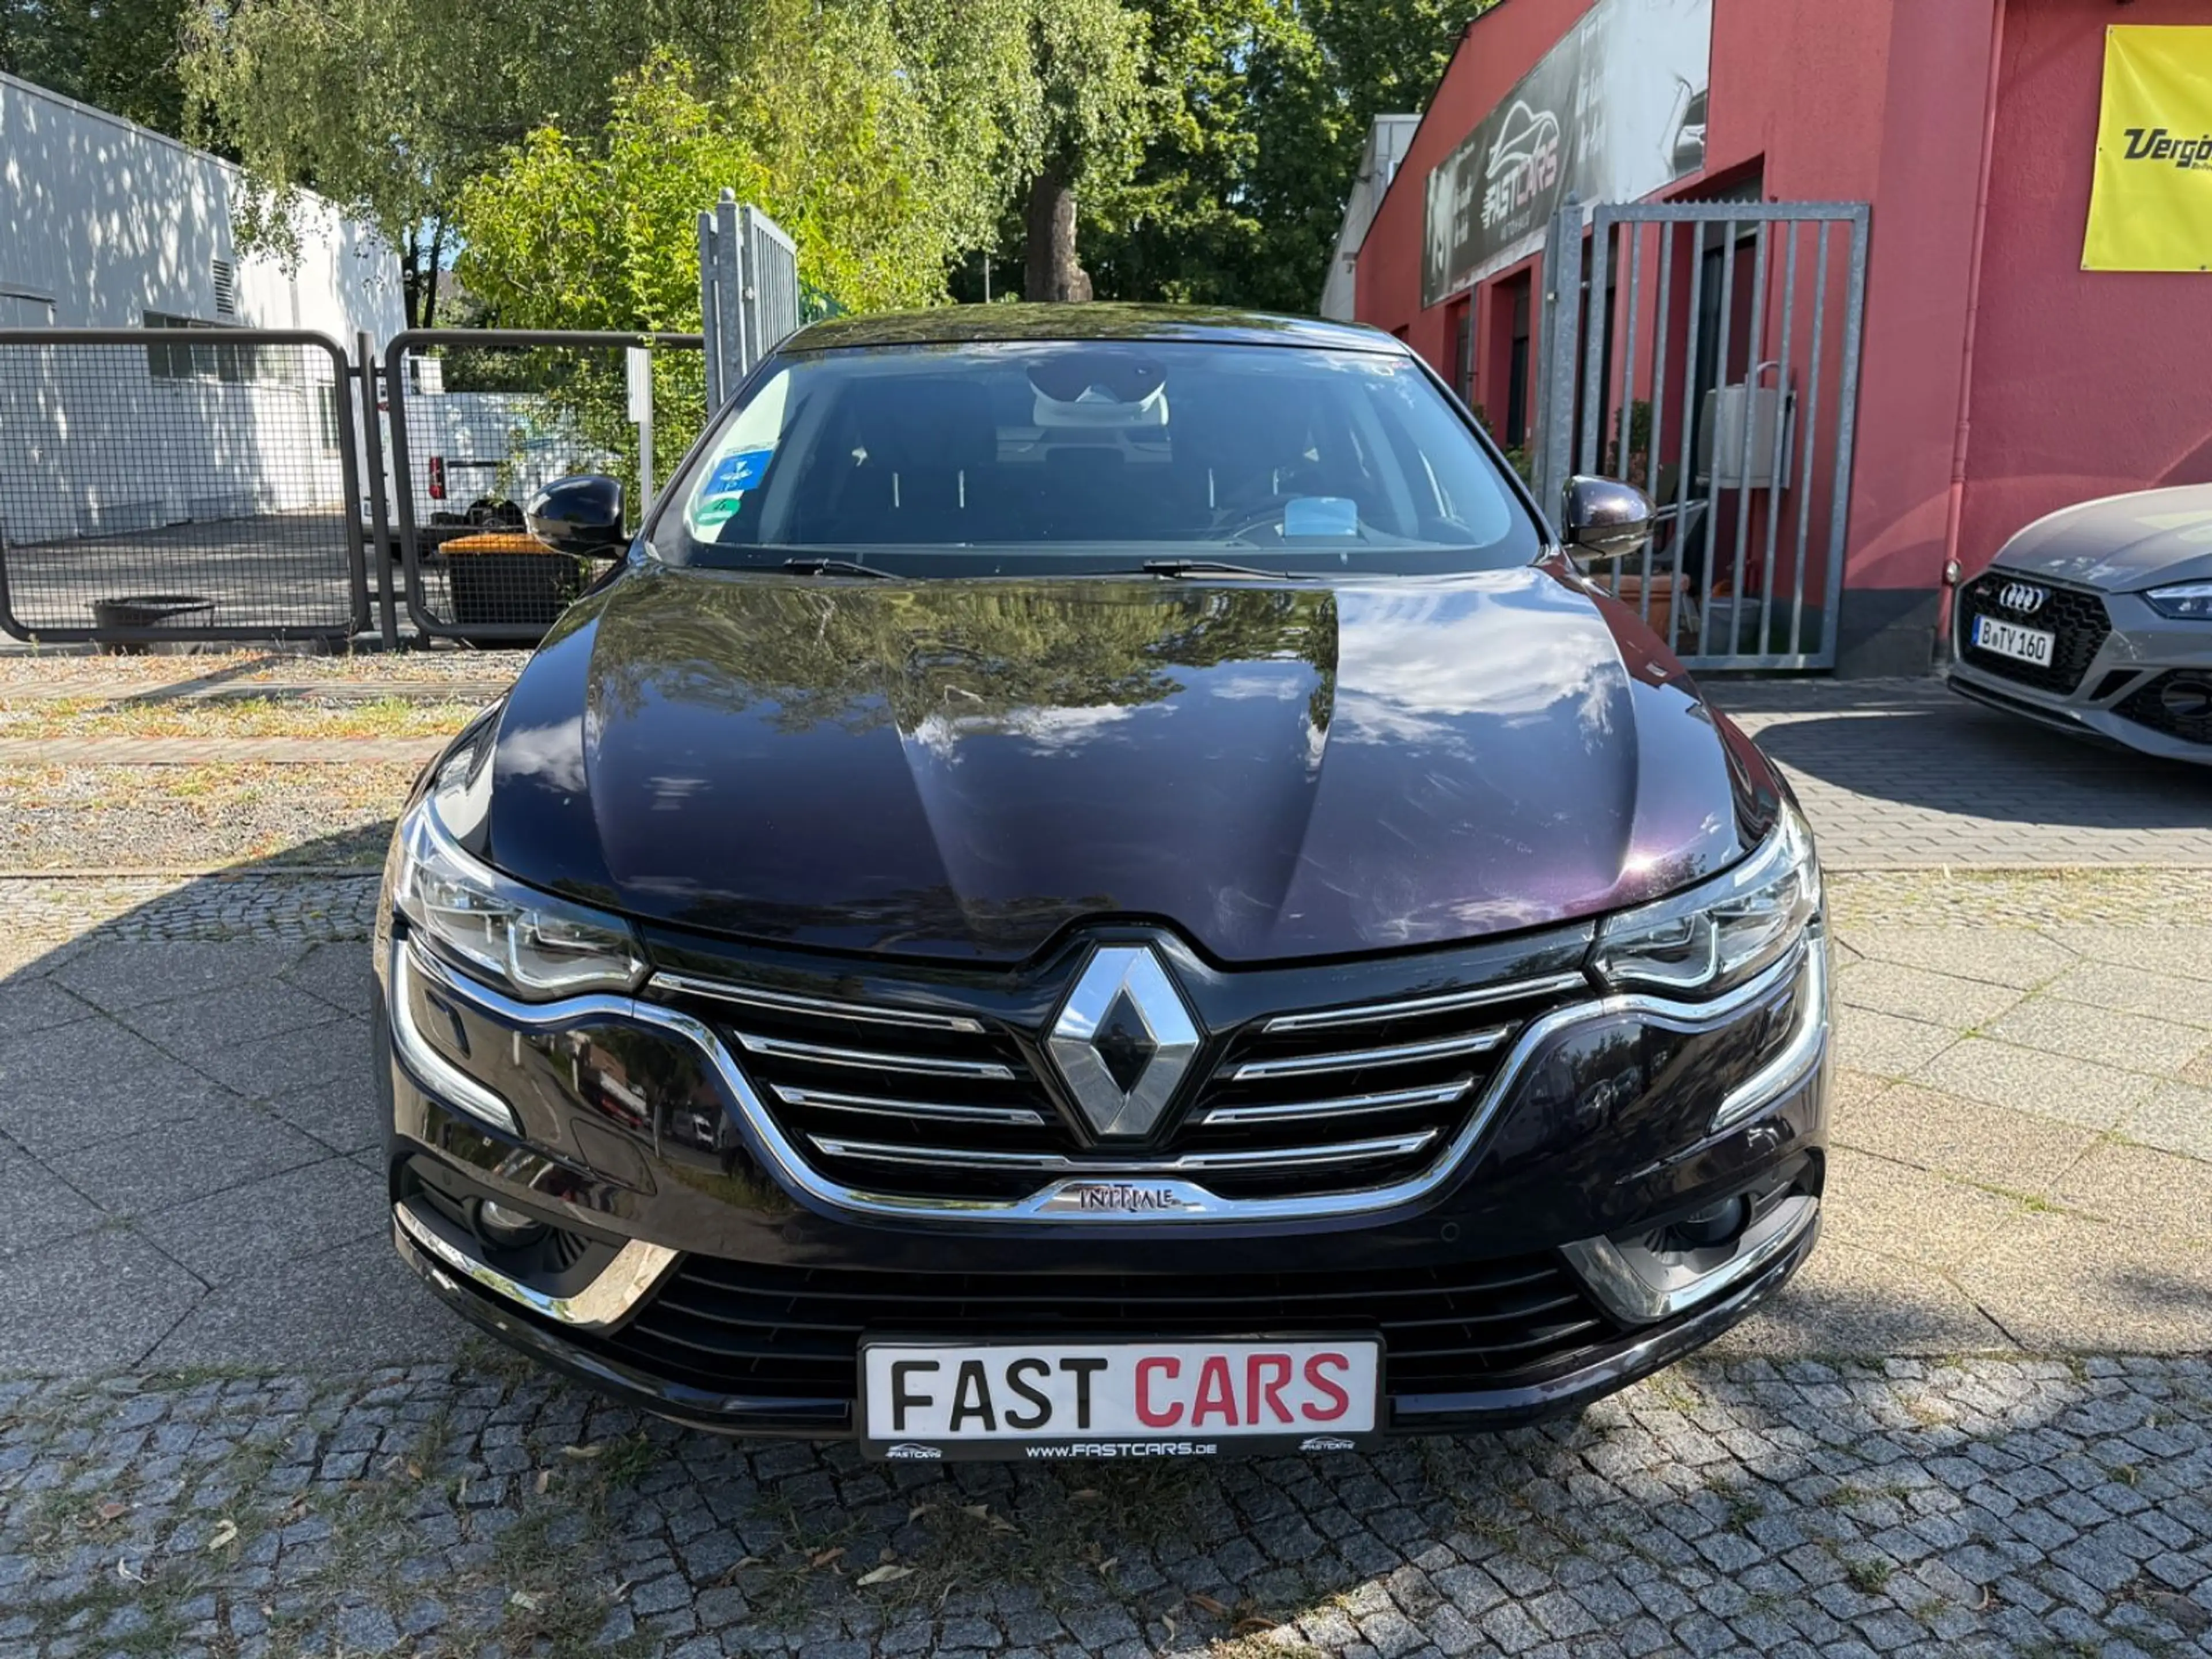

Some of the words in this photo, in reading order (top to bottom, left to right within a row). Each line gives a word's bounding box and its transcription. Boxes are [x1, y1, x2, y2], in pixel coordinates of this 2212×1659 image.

[1982, 622, 1991, 644] B
[1999, 626, 2016, 652] TY
[2017, 632, 2046, 660] 160
[1080, 1184, 1173, 1213] INITIALE
[891, 1358, 1107, 1432] FAST
[1135, 1353, 1349, 1427] CARS
